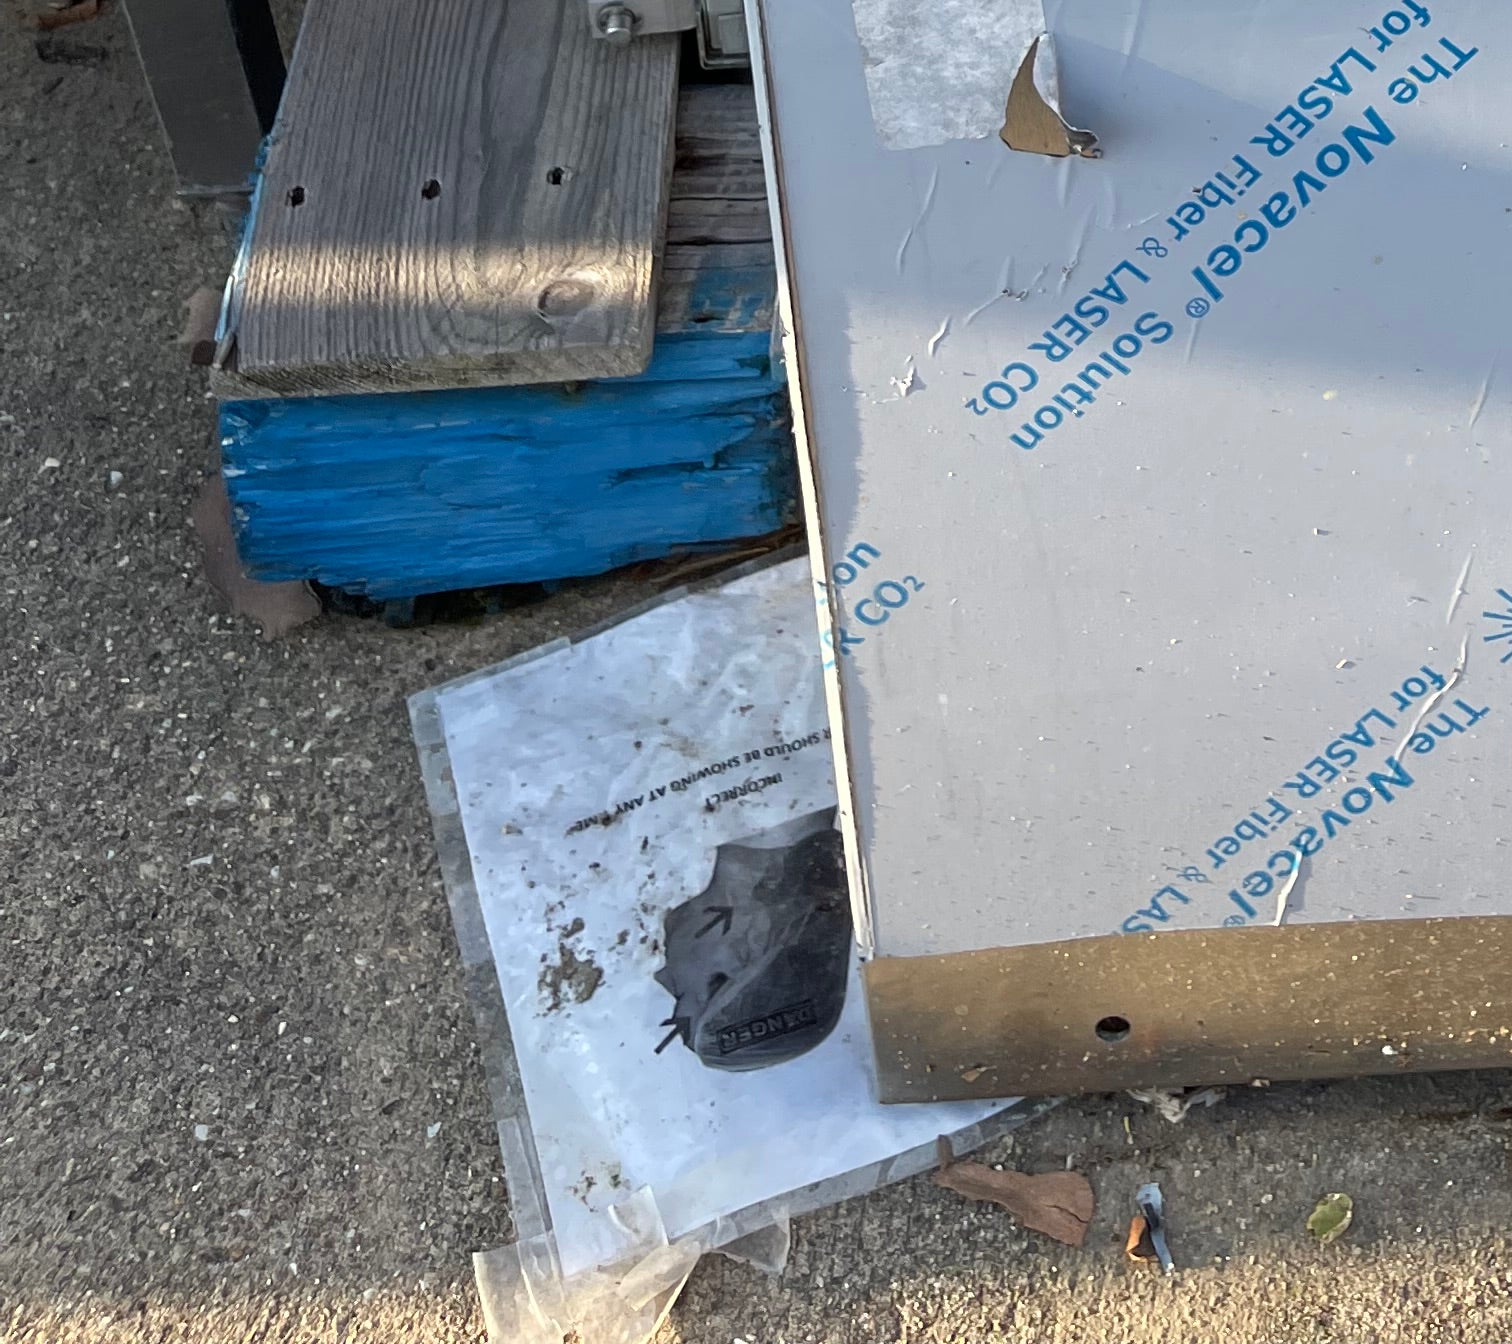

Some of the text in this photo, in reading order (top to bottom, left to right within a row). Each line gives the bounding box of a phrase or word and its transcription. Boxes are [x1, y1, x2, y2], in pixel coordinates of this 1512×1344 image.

[1386, 37, 1478, 105] The
[1250, 47, 1376, 157] LASER
[1166, 155, 1261, 241] Fiber
[1136, 235, 1169, 259] &
[1029, 259, 1149, 363] LASER
[1009, 312, 1174, 451] Solution
[764, 734, 821, 758] SHOULD
[1407, 699, 1489, 755] The
[669, 754, 742, 793] SHOWING
[745, 748, 761, 764] BE
[614, 794, 646, 816] ANY
[647, 784, 668, 803] AT
[703, 771, 784, 807] INCORRECT
[1121, 665, 1446, 933] for LASER Fiber & LAS
